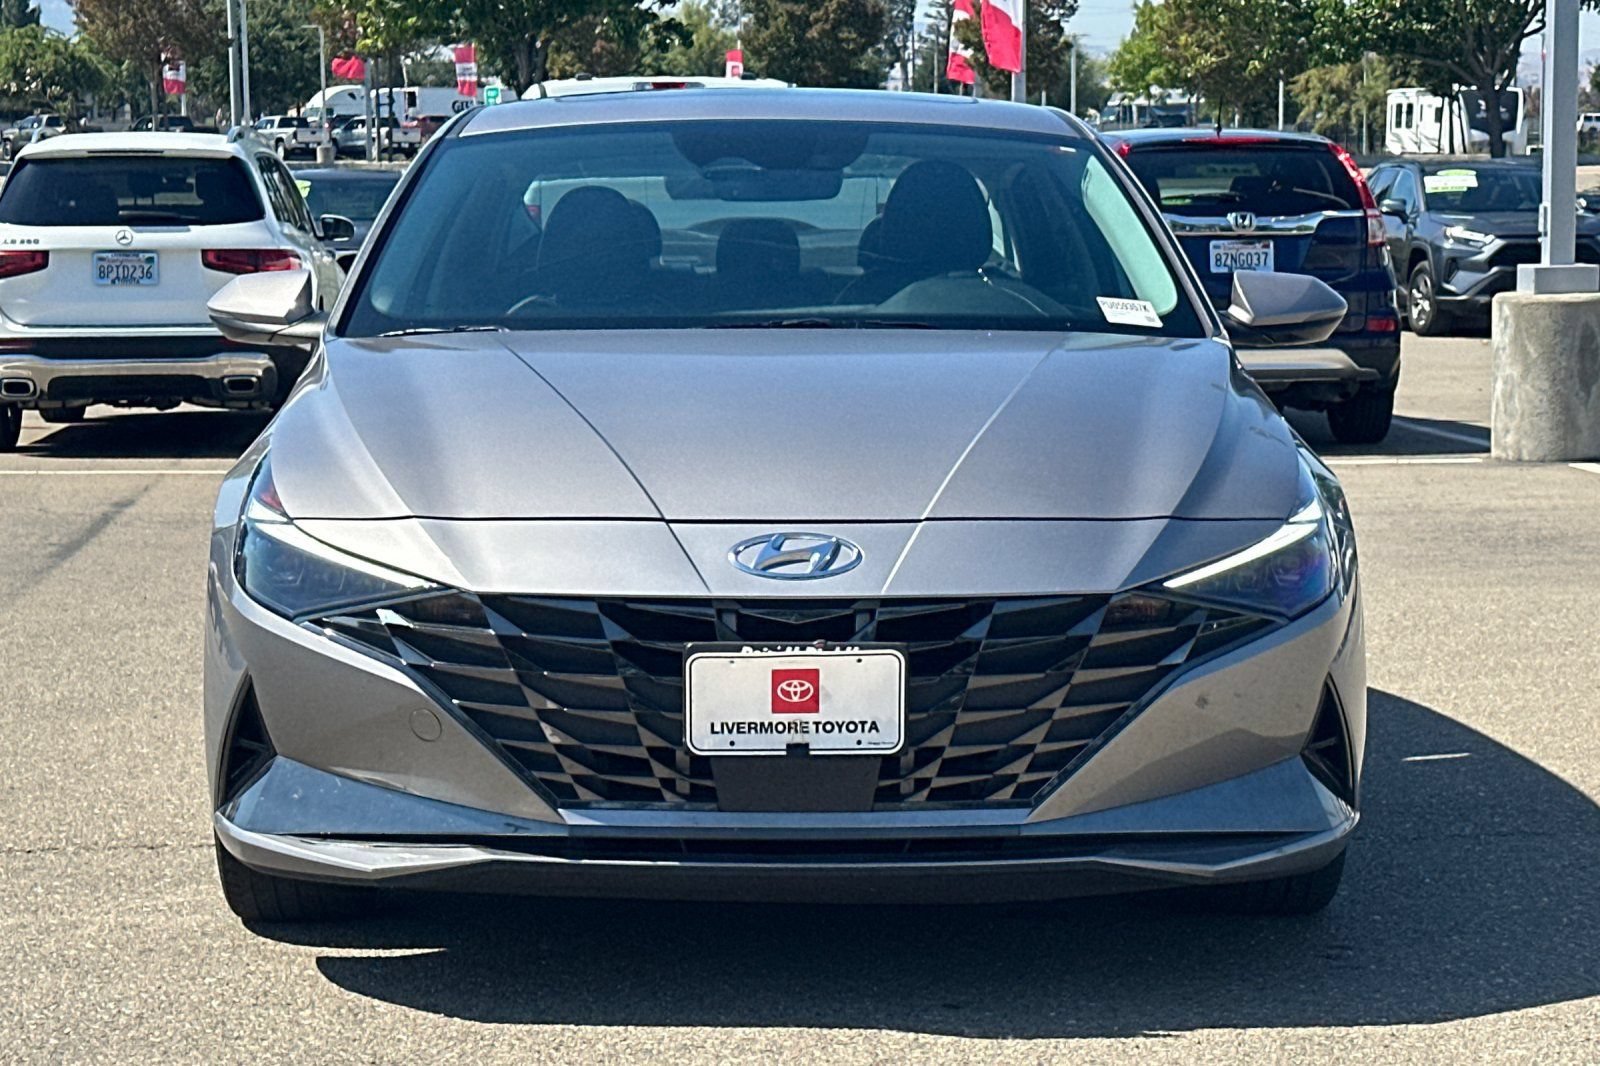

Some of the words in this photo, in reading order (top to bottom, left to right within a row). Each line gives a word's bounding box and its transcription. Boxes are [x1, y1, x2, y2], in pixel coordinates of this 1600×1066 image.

[1214, 251, 1269, 268] 8ZNG037
[98, 264, 153, 280] 8PID236
[710, 721, 809, 735] LIVERMORE
[814, 720, 880, 734] TOYOTA
